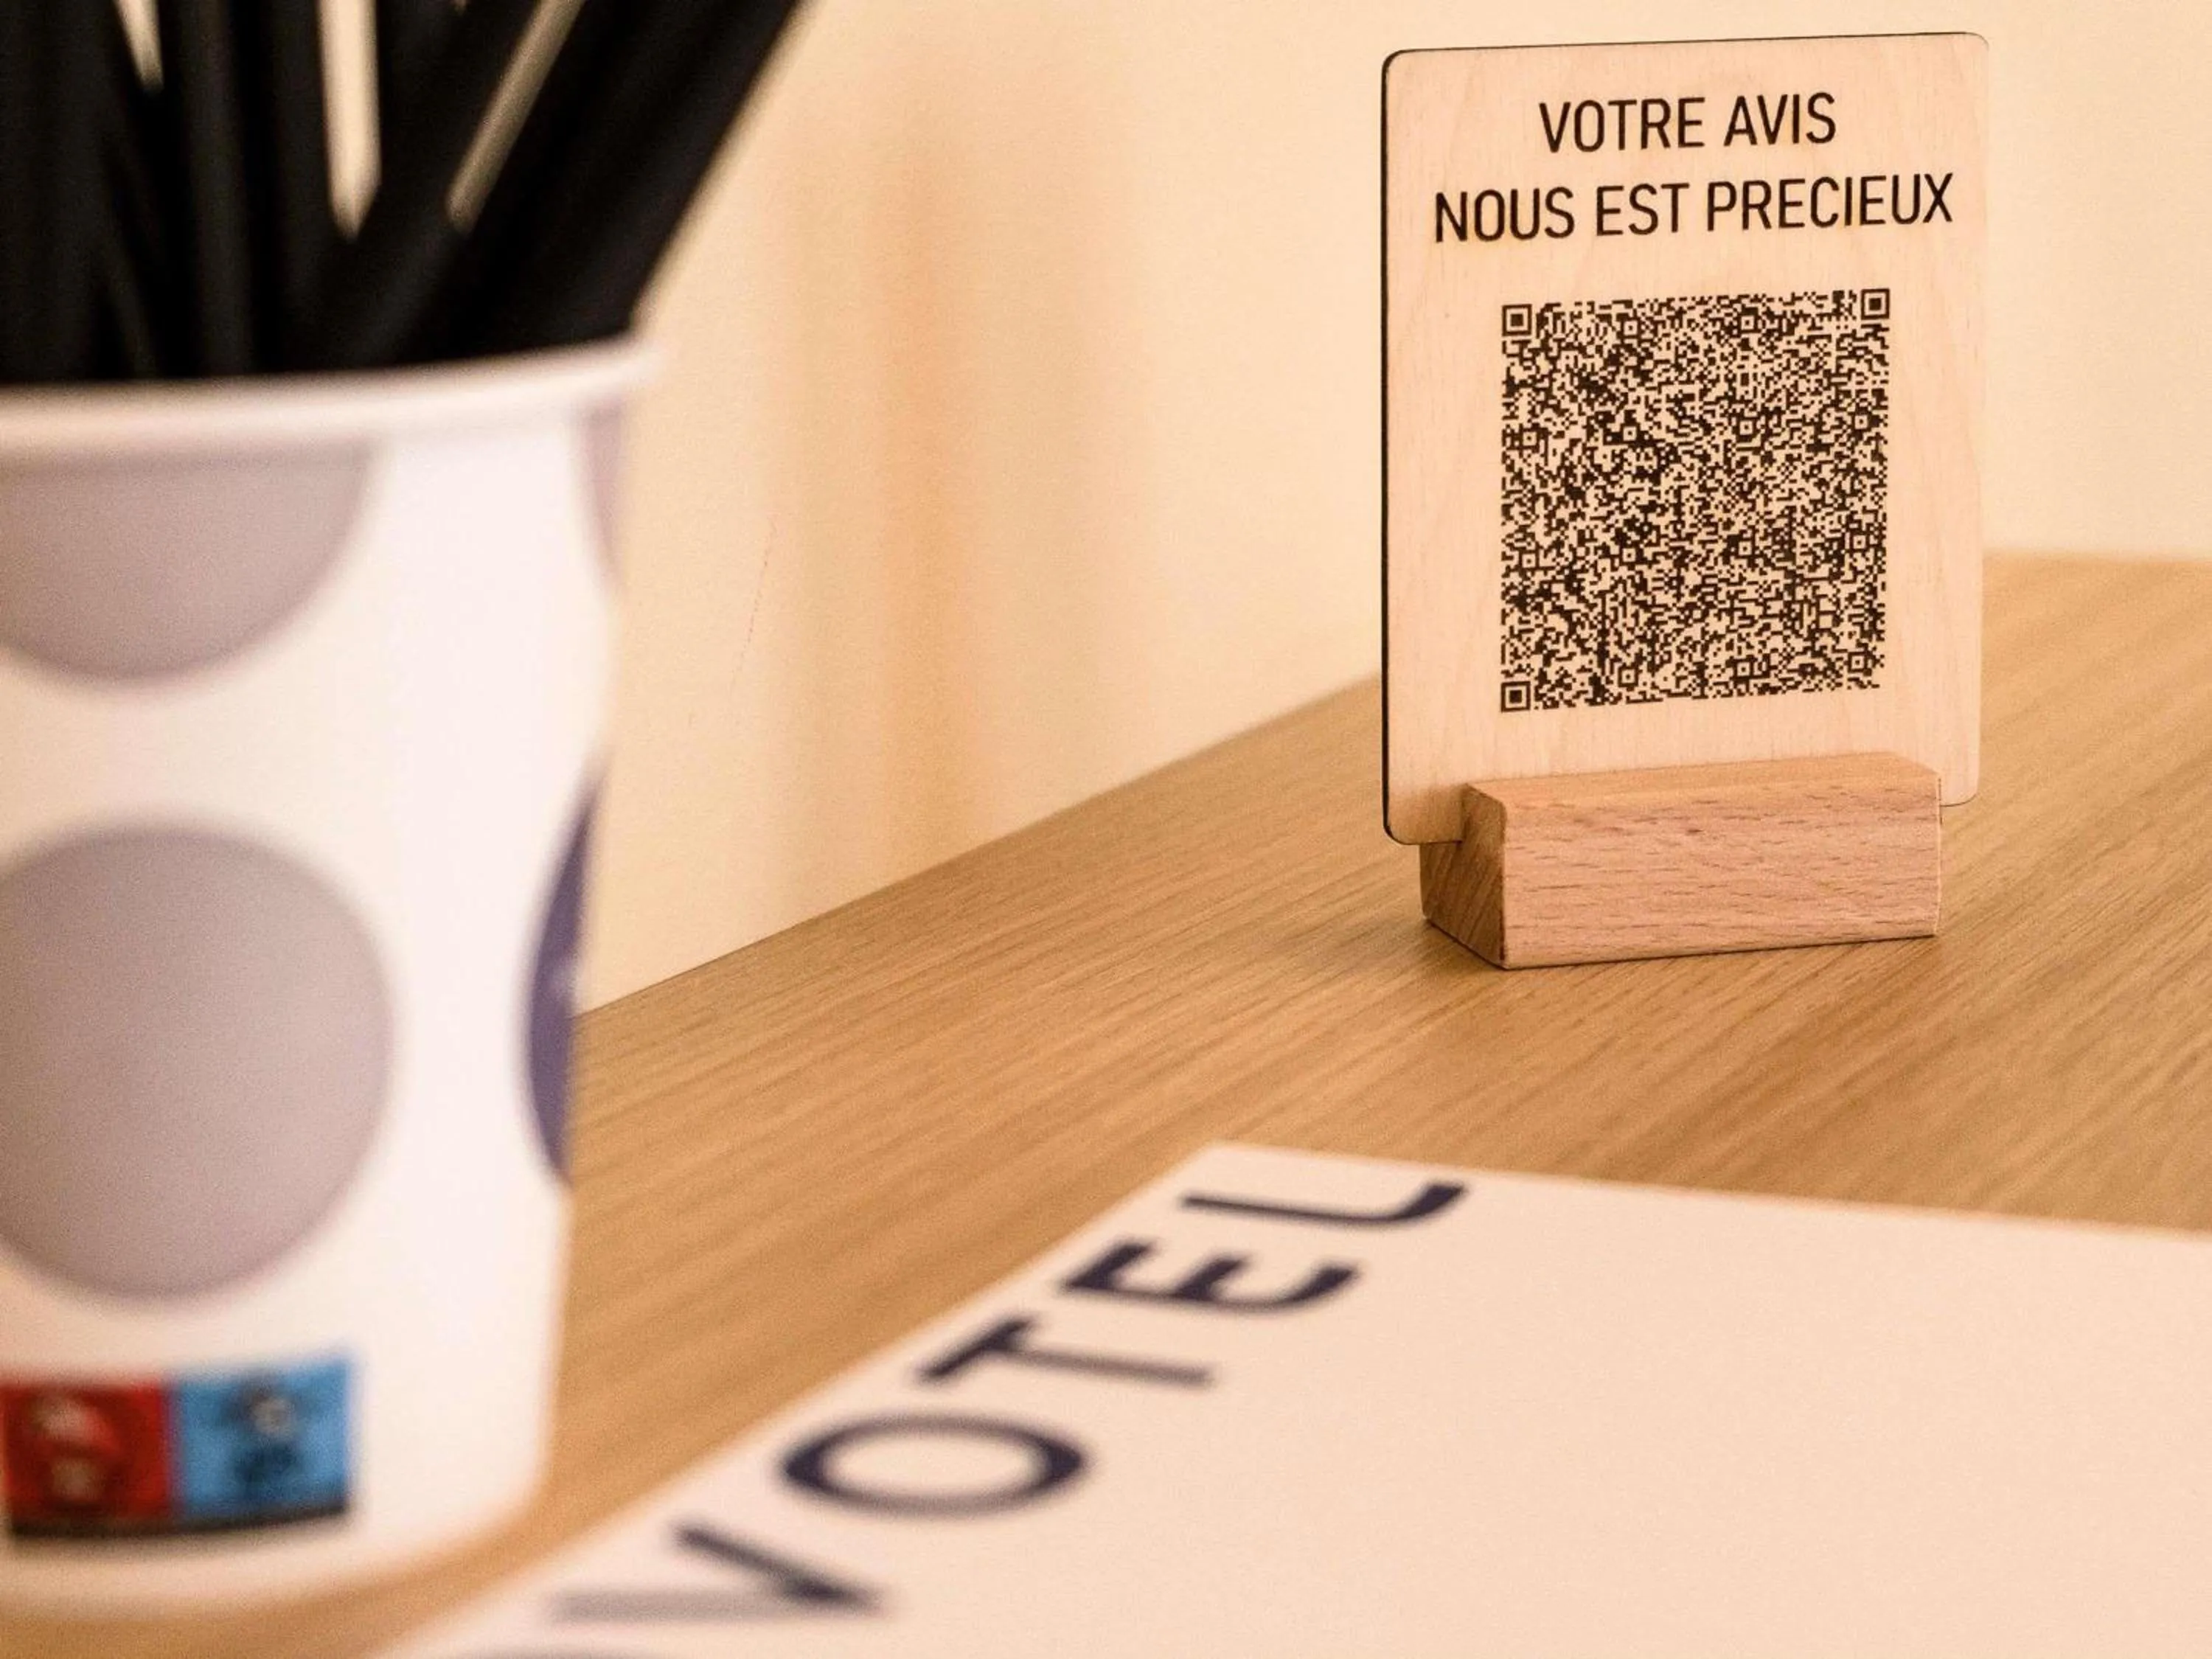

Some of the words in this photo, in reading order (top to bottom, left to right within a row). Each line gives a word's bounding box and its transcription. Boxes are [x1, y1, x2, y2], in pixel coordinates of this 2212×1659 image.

[1539, 97, 1705, 153] VOTRE
[1723, 91, 1837, 147] AVIS
[1435, 186, 1575, 243] NOUS
[1596, 182, 1690, 237] EST
[1707, 173, 1953, 232] PRECIEUX
[450, 1180, 1469, 1659] VOTEL
